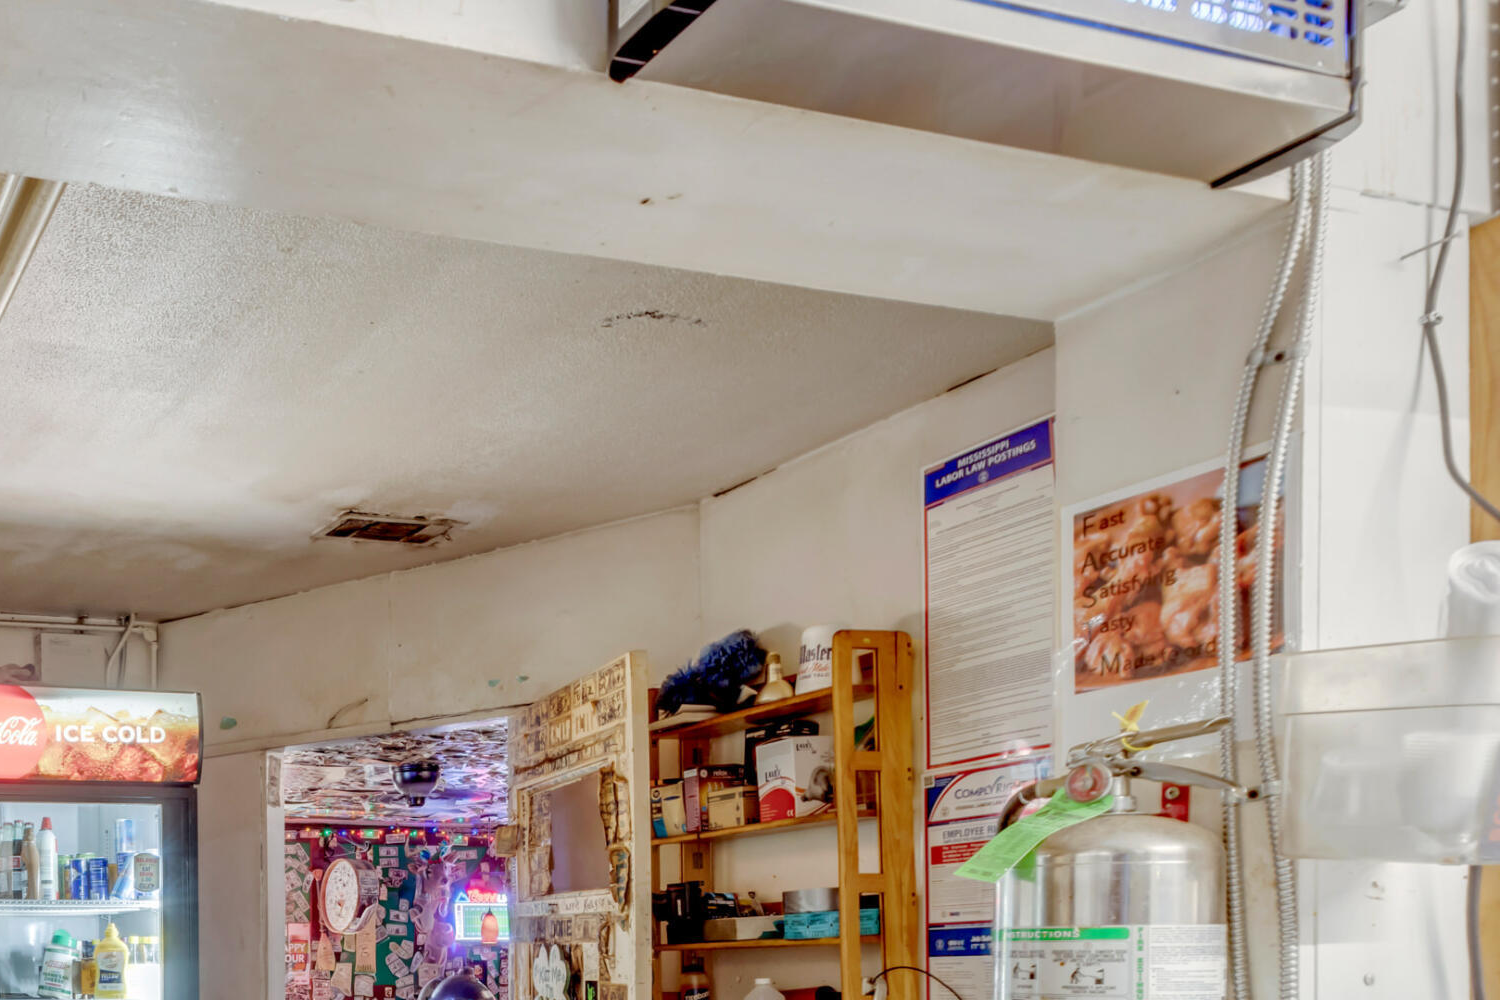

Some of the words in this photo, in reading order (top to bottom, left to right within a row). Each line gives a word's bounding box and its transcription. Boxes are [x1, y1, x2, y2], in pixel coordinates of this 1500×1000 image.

[935, 468, 965, 488] LABOR
[965, 460, 987, 476] LAW
[987, 439, 1037, 467] POSTINGS
[957, 439, 1010, 468] MISSISSIPPI
[1082, 509, 1126, 538] Fast
[1081, 536, 1166, 574] Accurate
[1186, 635, 1218, 658] ord
[55, 725, 96, 743] ICE
[102, 725, 167, 744] COLD
[942, 824, 984, 840] EMPLOYEE
[285, 943, 308, 953] APPY
[285, 954, 305, 963] OUR
